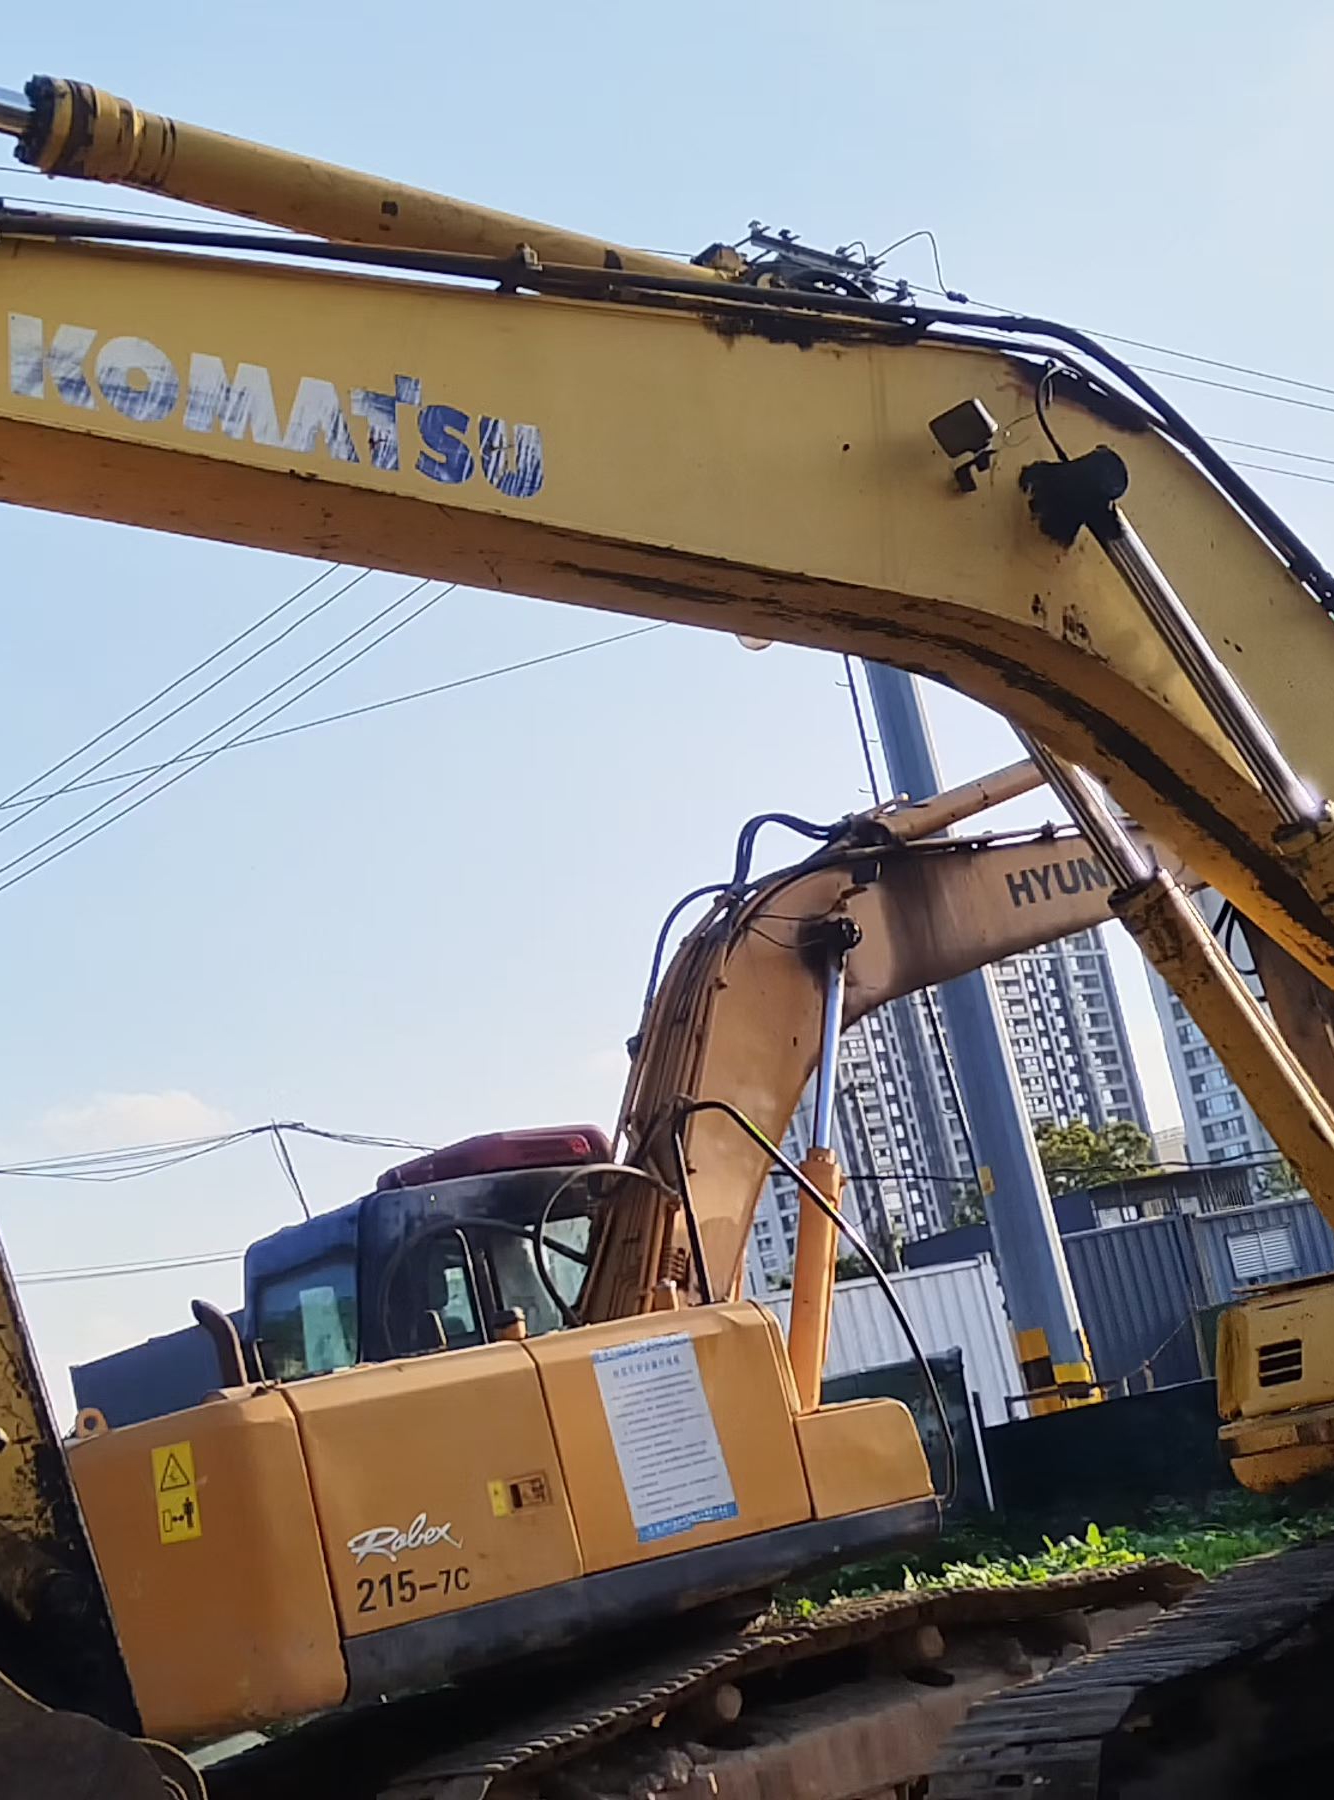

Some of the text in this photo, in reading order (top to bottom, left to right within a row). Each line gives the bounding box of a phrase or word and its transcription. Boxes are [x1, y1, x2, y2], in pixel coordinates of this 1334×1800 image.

[8, 312, 544, 498] KOMATSU
[1005, 856, 1116, 907] HYUN
[347, 1512, 464, 1564] Robex
[357, 1567, 471, 1613] 215-7C
